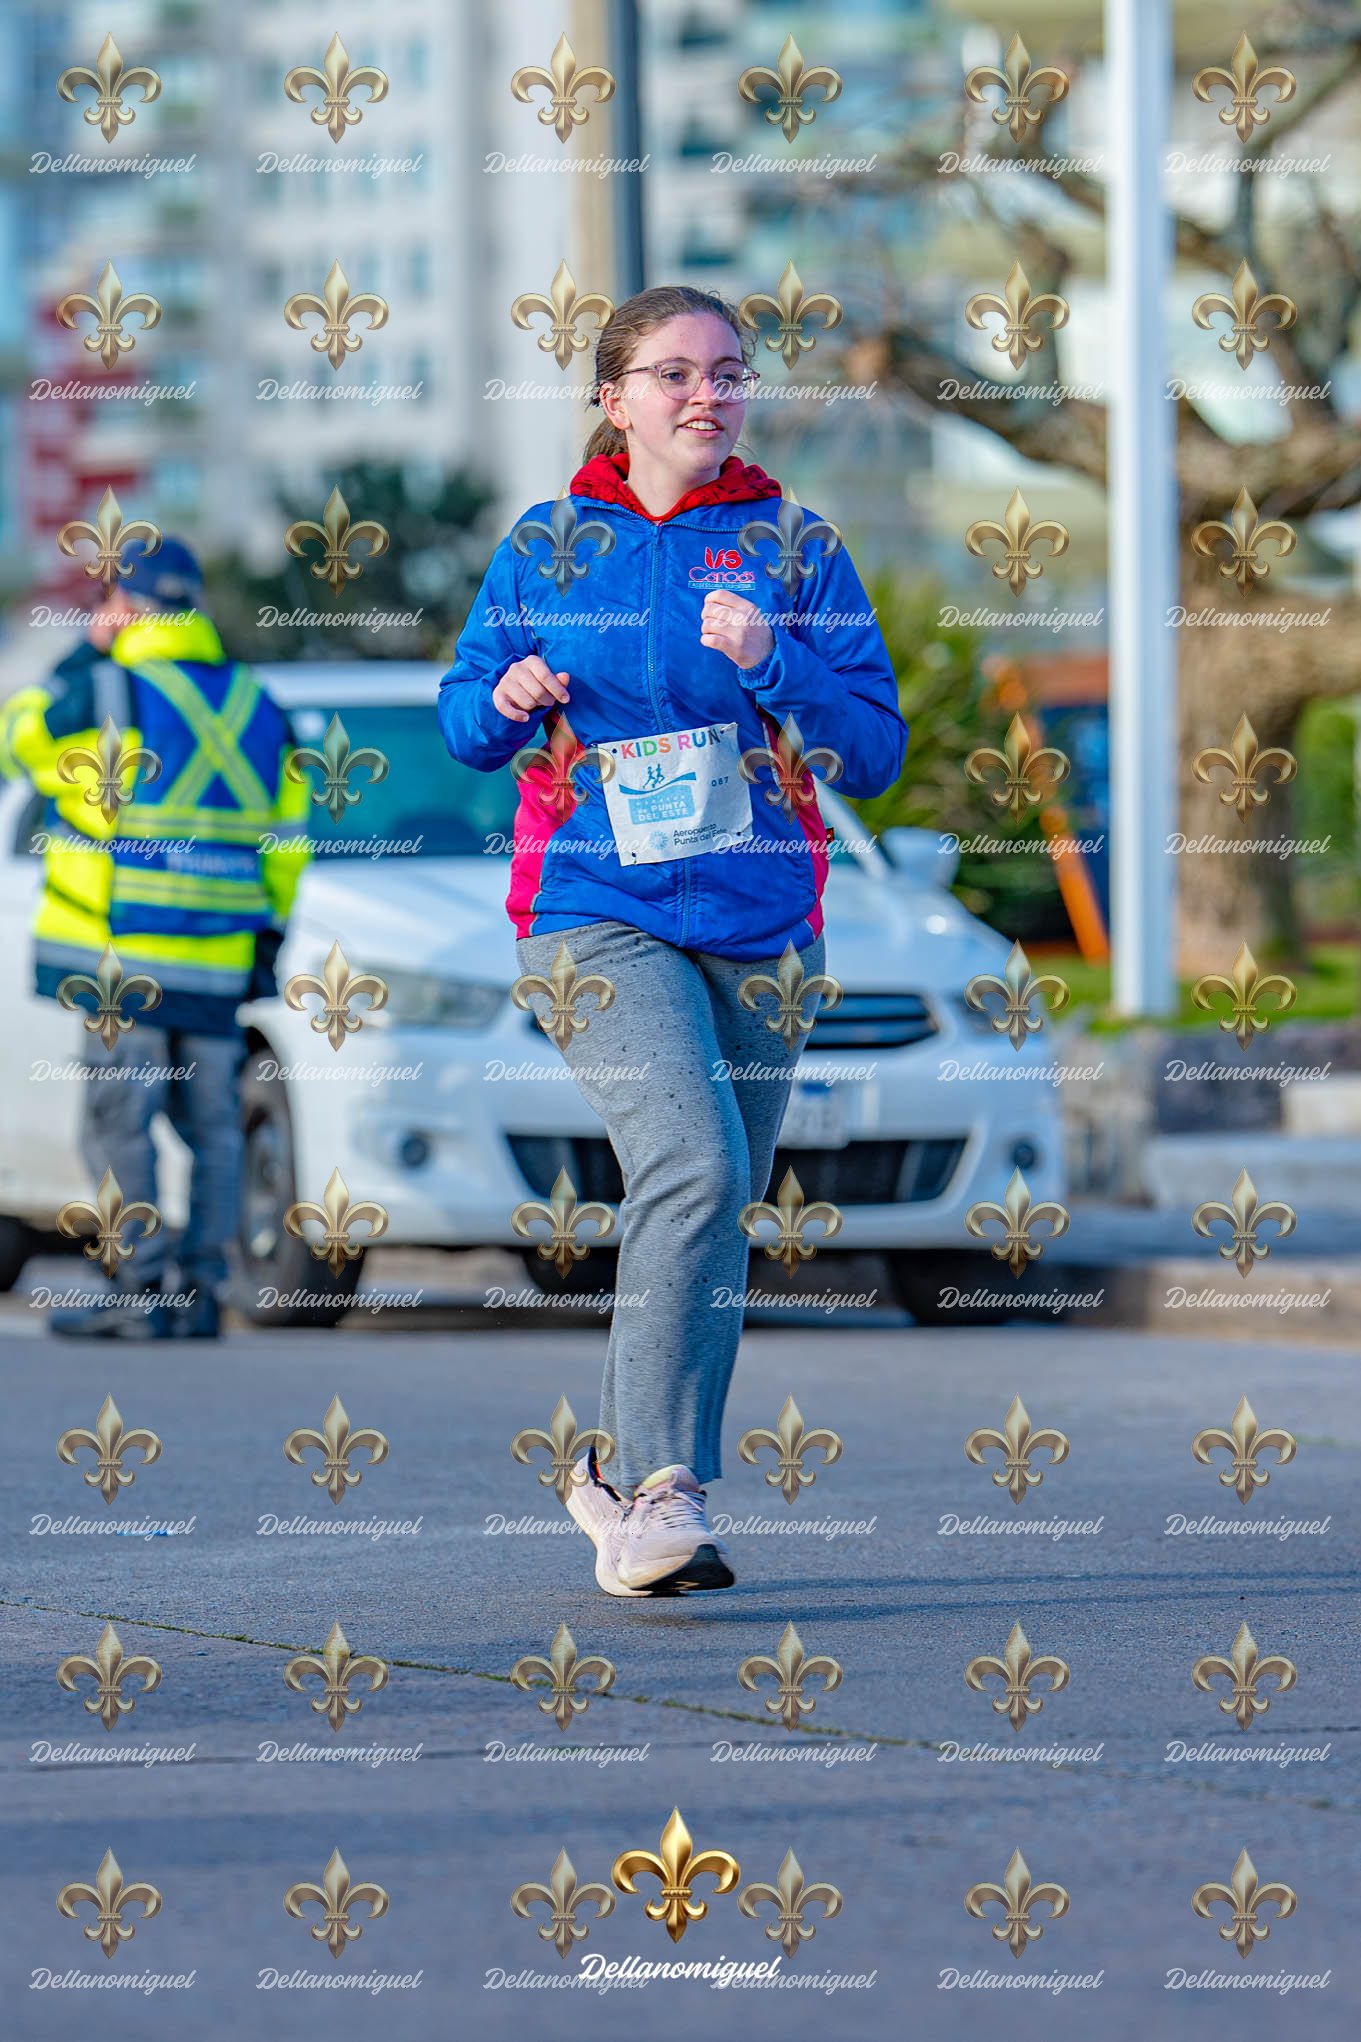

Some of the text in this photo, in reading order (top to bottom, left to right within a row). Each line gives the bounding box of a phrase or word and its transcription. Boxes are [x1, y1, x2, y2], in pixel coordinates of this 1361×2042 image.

[621, 729, 720, 759] KIDS RUN
[651, 801, 687, 812] PUNTA
[638, 809, 688, 822] DEL ESTE
[673, 823, 717, 838] Aeropuerto
[674, 836, 698, 846] Punta
